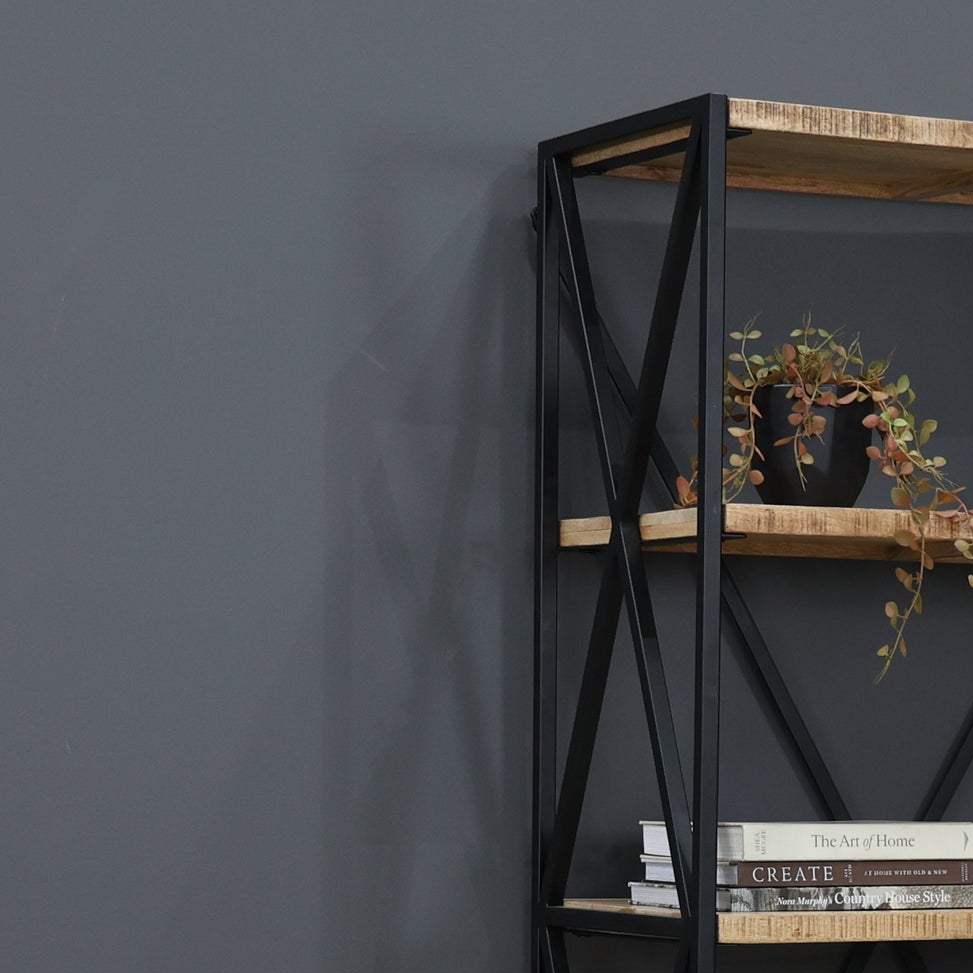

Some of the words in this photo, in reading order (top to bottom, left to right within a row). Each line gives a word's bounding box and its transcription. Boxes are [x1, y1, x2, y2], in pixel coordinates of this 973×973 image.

[811, 834, 837, 848] The
[839, 834, 860, 848] Art
[862, 834, 876, 851] of
[876, 834, 915, 848] Home
[752, 866, 834, 882] CREATE
[776, 897, 796, 906] Nora
[834, 892, 882, 904] Country
[884, 891, 920, 903] House
[922, 890, 951, 905] Style
